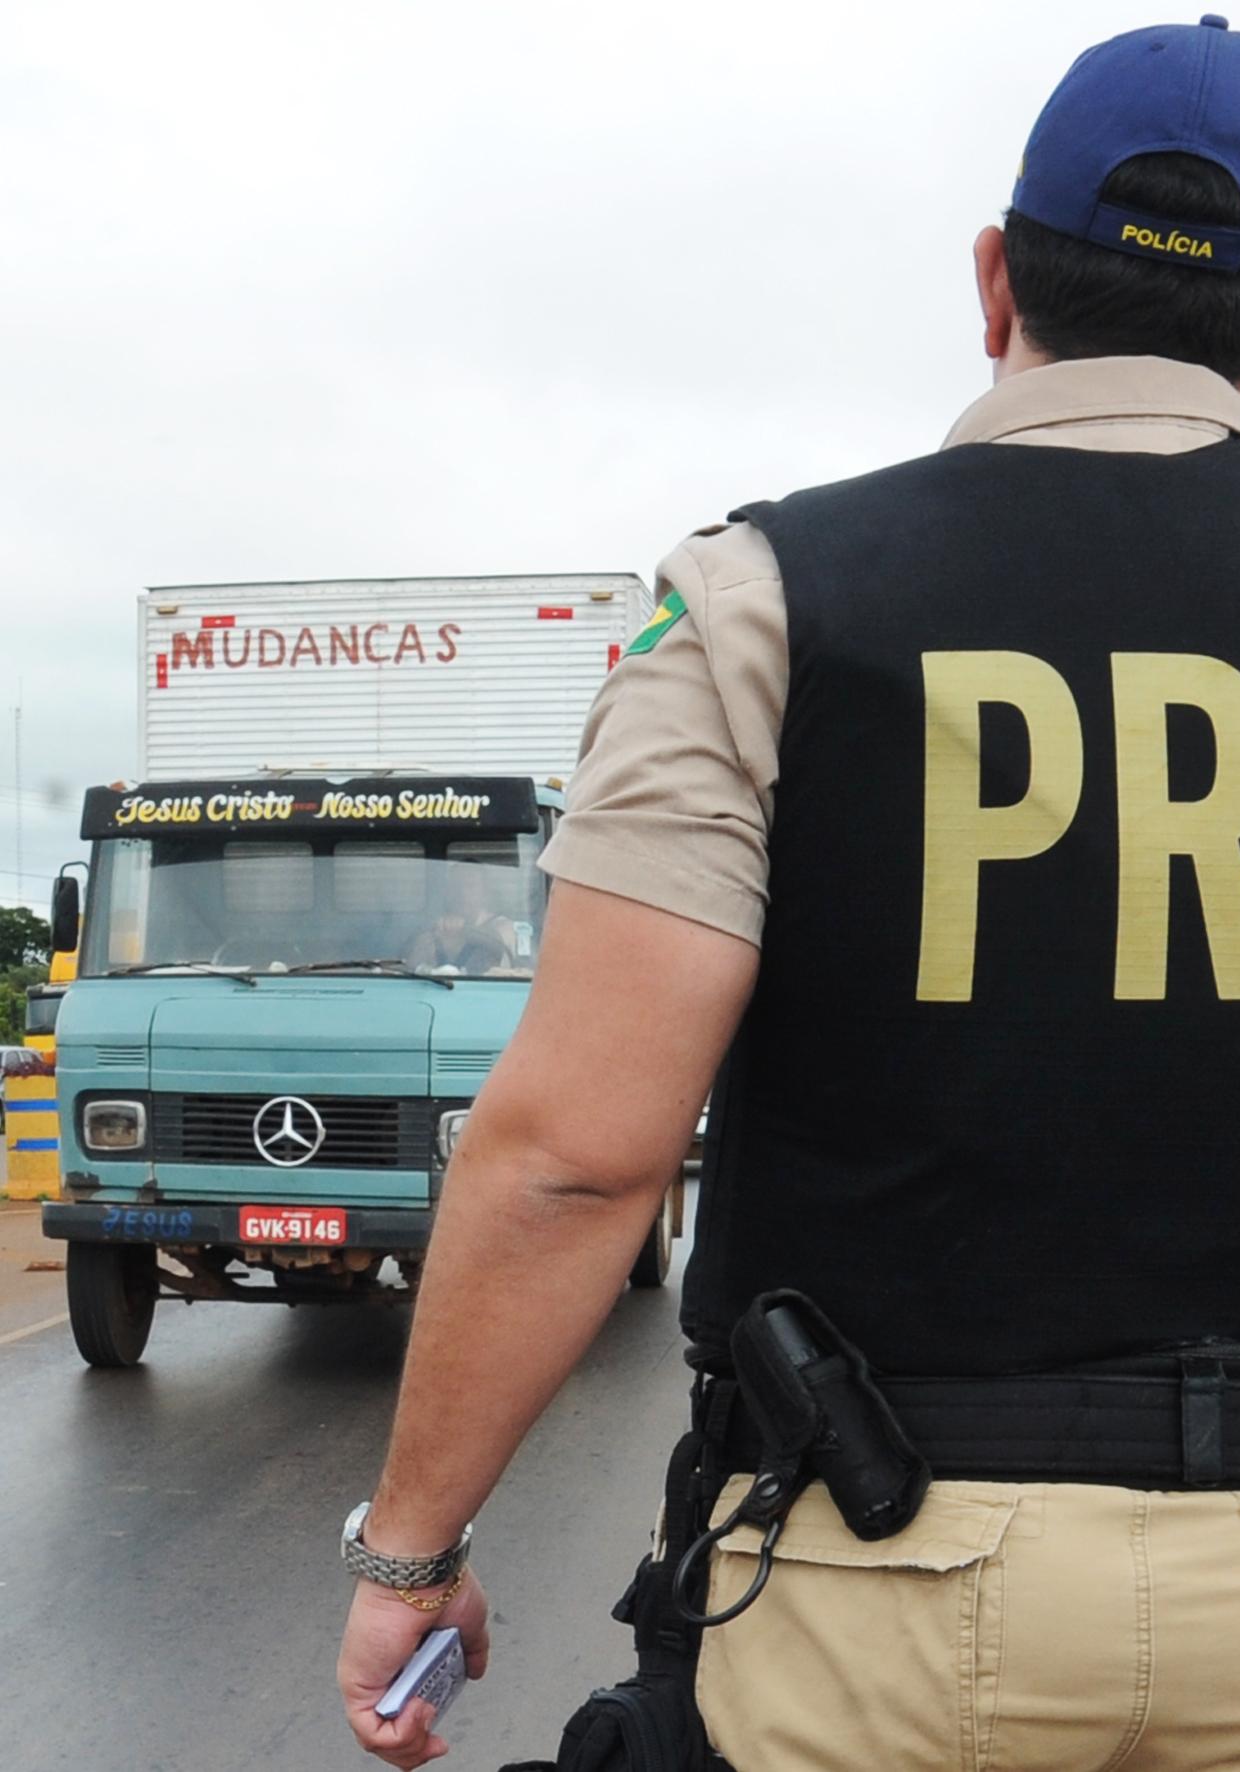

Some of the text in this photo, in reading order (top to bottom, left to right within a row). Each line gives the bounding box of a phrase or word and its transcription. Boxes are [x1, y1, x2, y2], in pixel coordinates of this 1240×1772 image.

[1121, 224, 1213, 258] POLÍCIA
[171, 622, 462, 670] MUDANCAS
[115, 786, 490, 823] Jesus Cristo Nosso Senhor
[246, 1217, 340, 1240] GVK-9146
